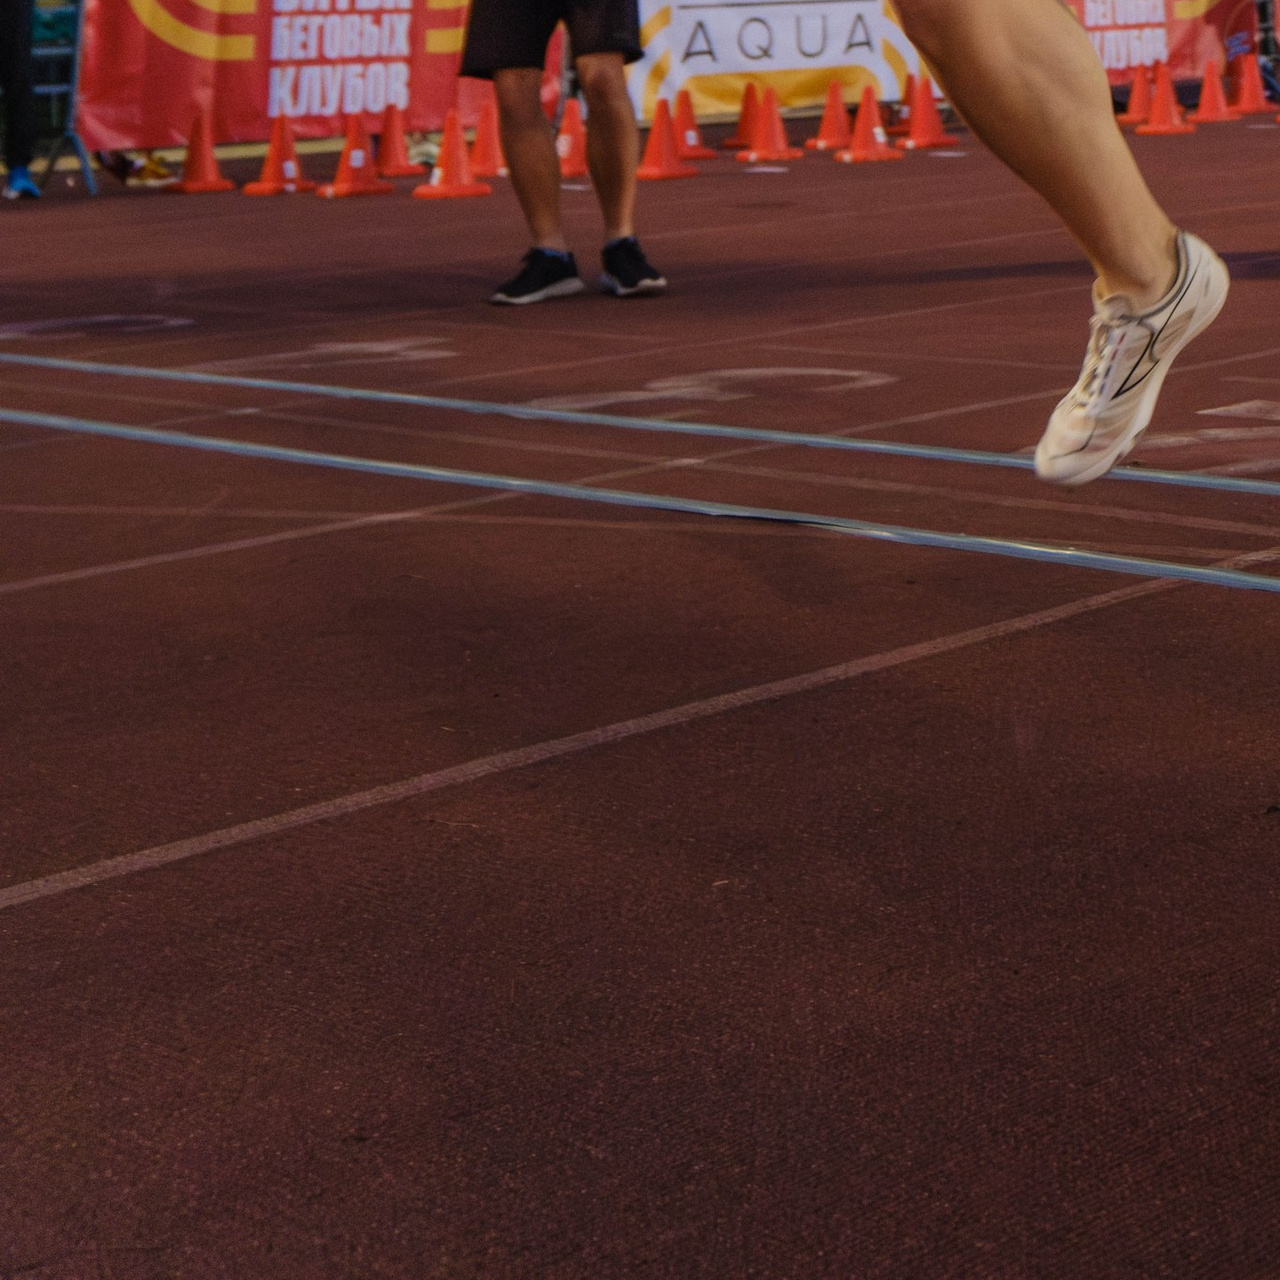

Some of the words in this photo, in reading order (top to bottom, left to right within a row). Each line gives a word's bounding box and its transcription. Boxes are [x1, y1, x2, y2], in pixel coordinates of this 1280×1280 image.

[271, 13, 411, 60] БЕГОВЫХ
[681, 13, 873, 62] AQUA
[268, 62, 409, 117] КЛУБОВ
